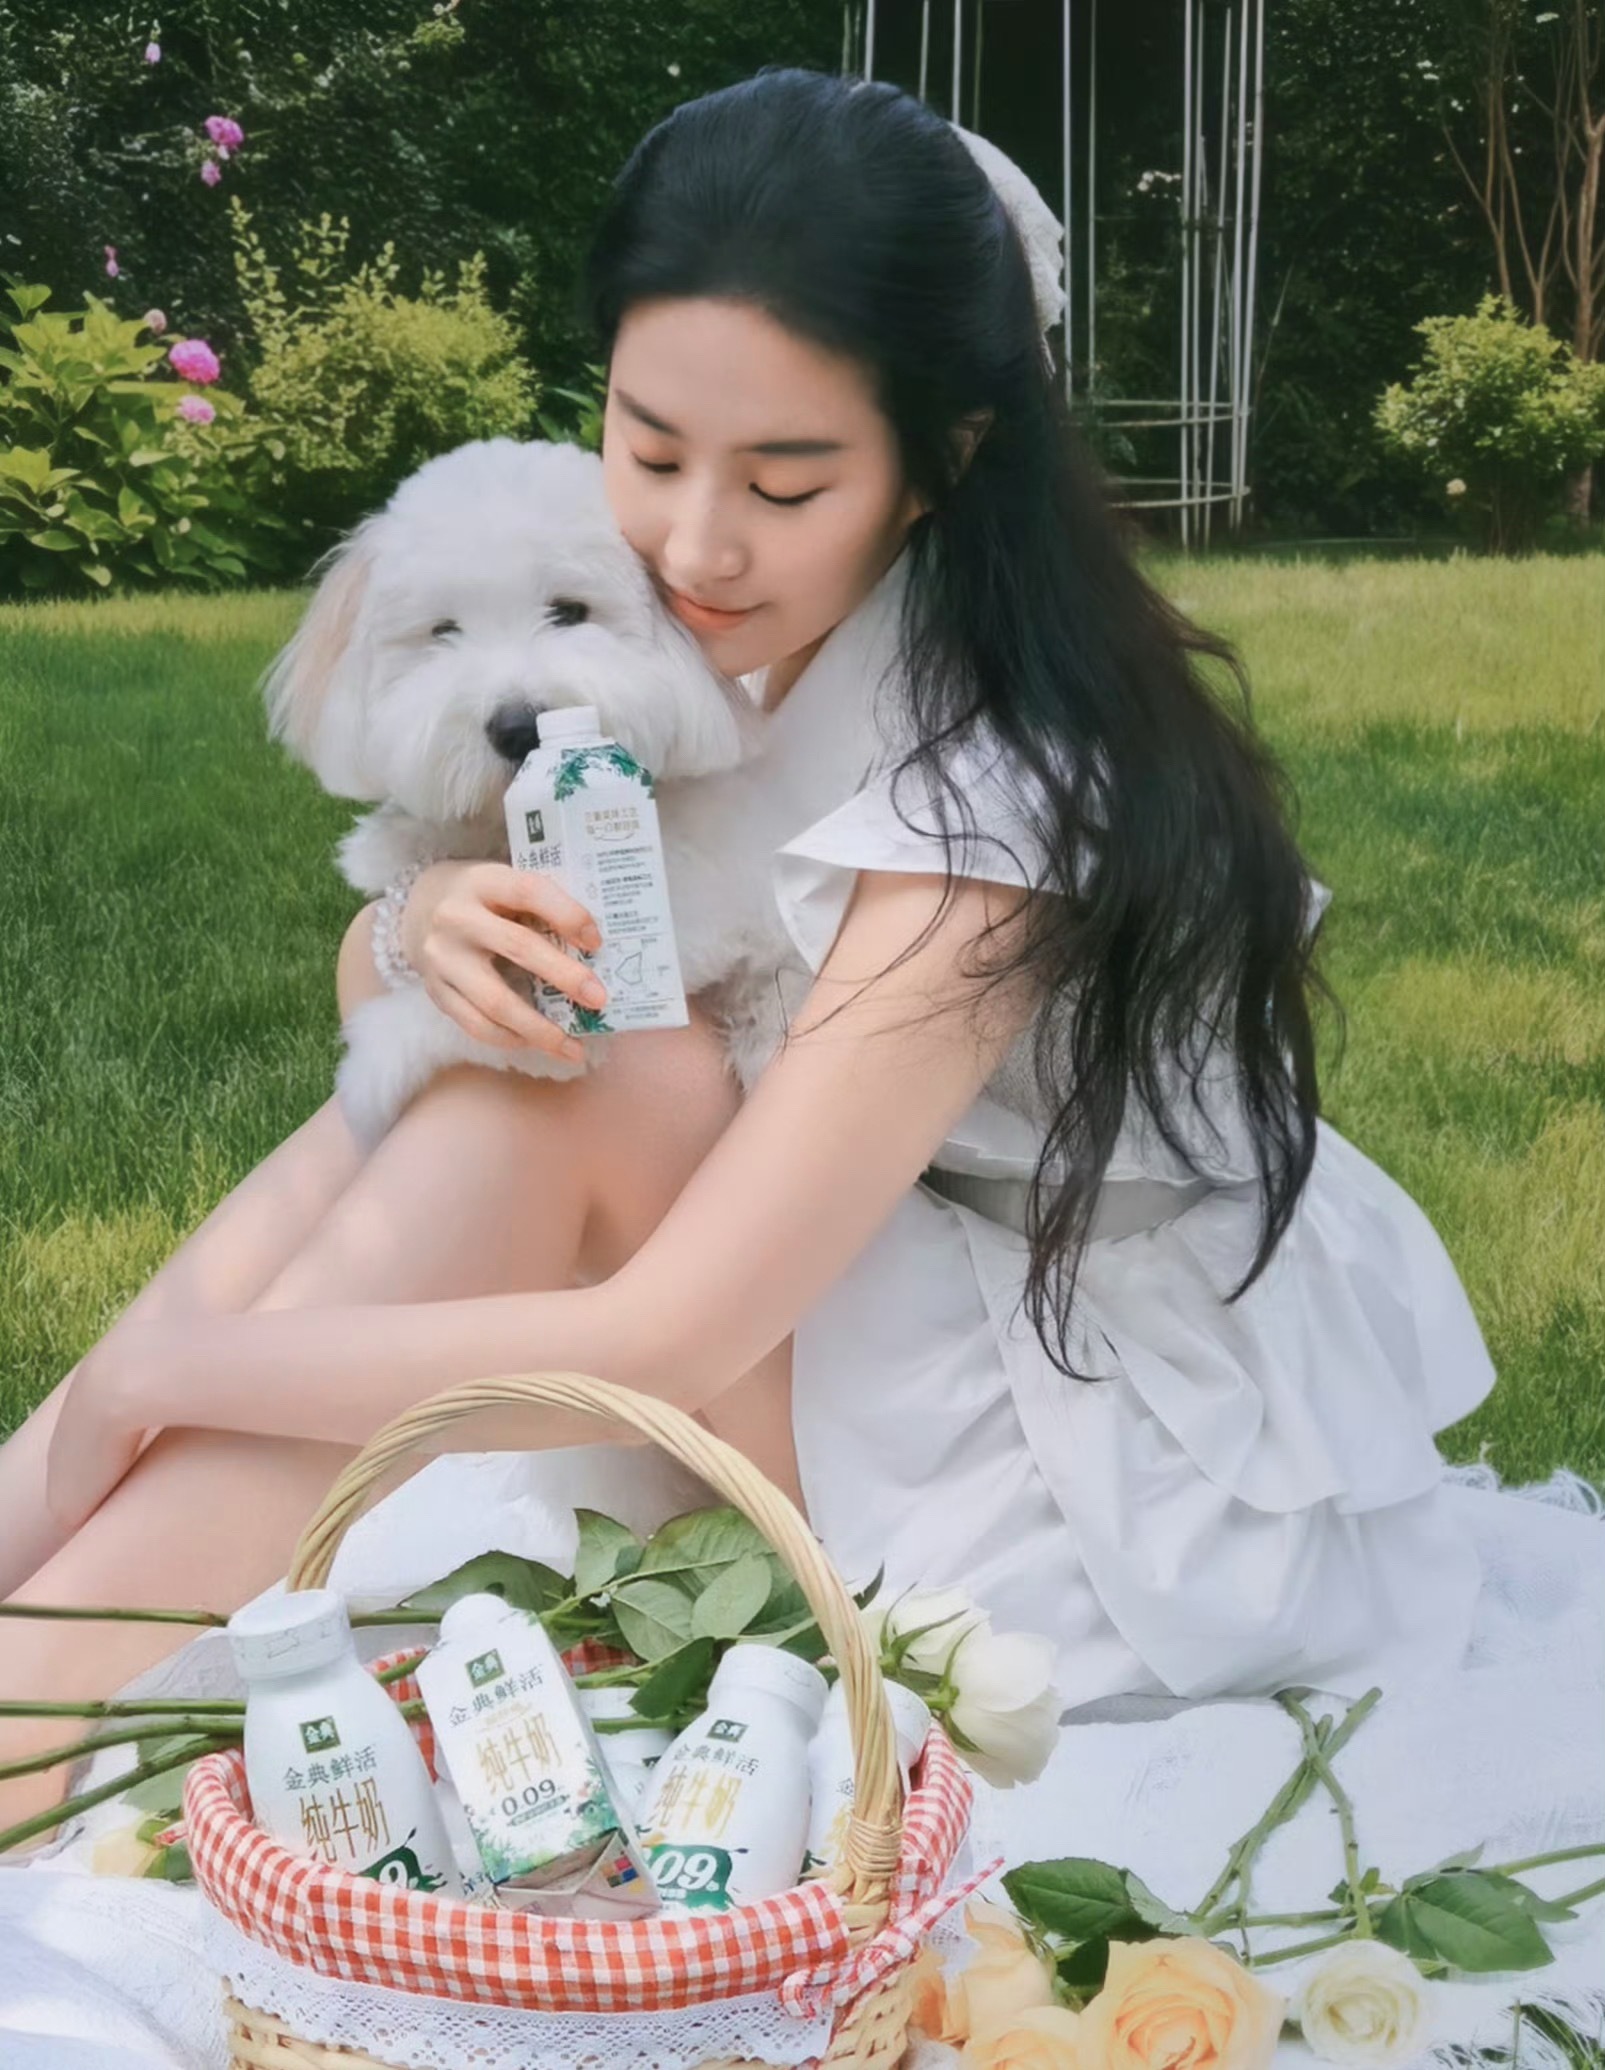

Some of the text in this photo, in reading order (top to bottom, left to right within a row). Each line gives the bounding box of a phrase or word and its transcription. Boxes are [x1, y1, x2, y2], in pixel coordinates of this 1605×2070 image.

[449, 1666, 544, 1727] 金典鲜活
[303, 1719, 337, 1747] 金典
[476, 1713, 562, 1795] 纯牛奶
[672, 1744, 760, 1776] 金典鲜活
[283, 1745, 378, 1791] 金典鲜活
[299, 1776, 390, 1862] 纯牛奶
[648, 1765, 742, 1838] 纯牛奶
